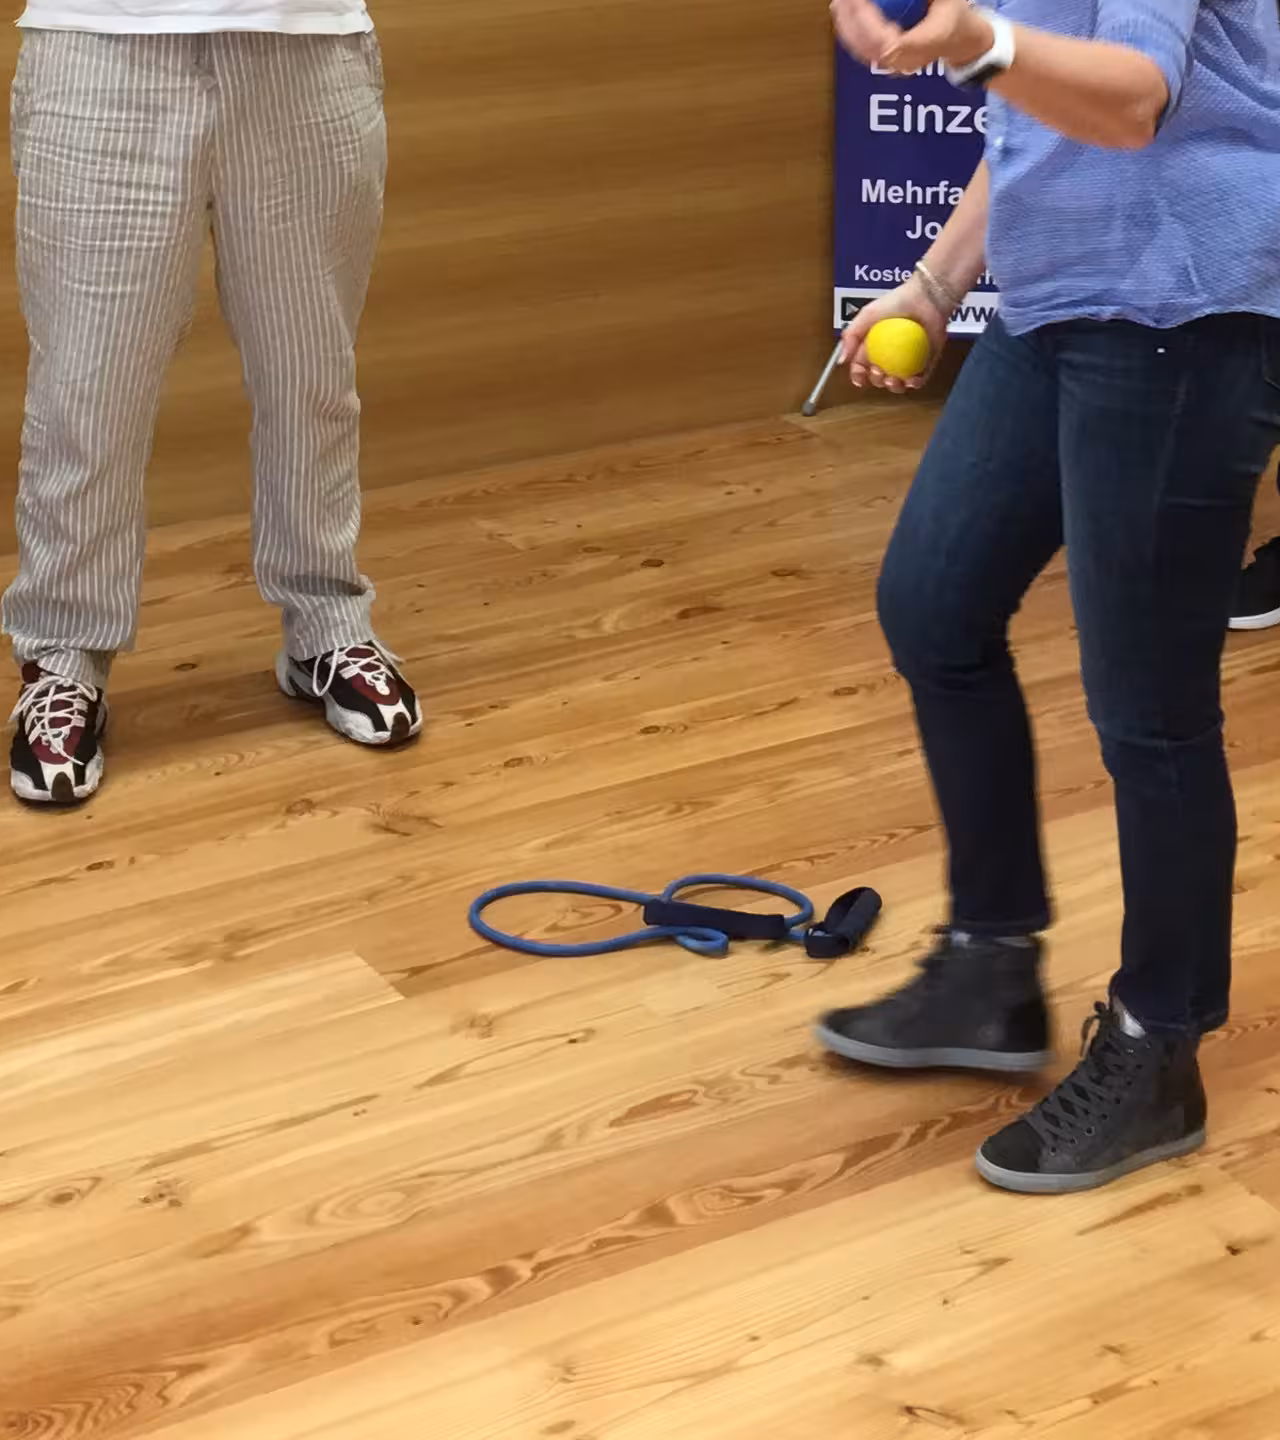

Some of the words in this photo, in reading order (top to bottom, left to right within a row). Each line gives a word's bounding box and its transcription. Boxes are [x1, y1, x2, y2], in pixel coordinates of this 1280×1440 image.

[869, 93, 988, 134] Einze
[861, 178, 965, 205] Mehrfa
[854, 264, 913, 282] Koste
